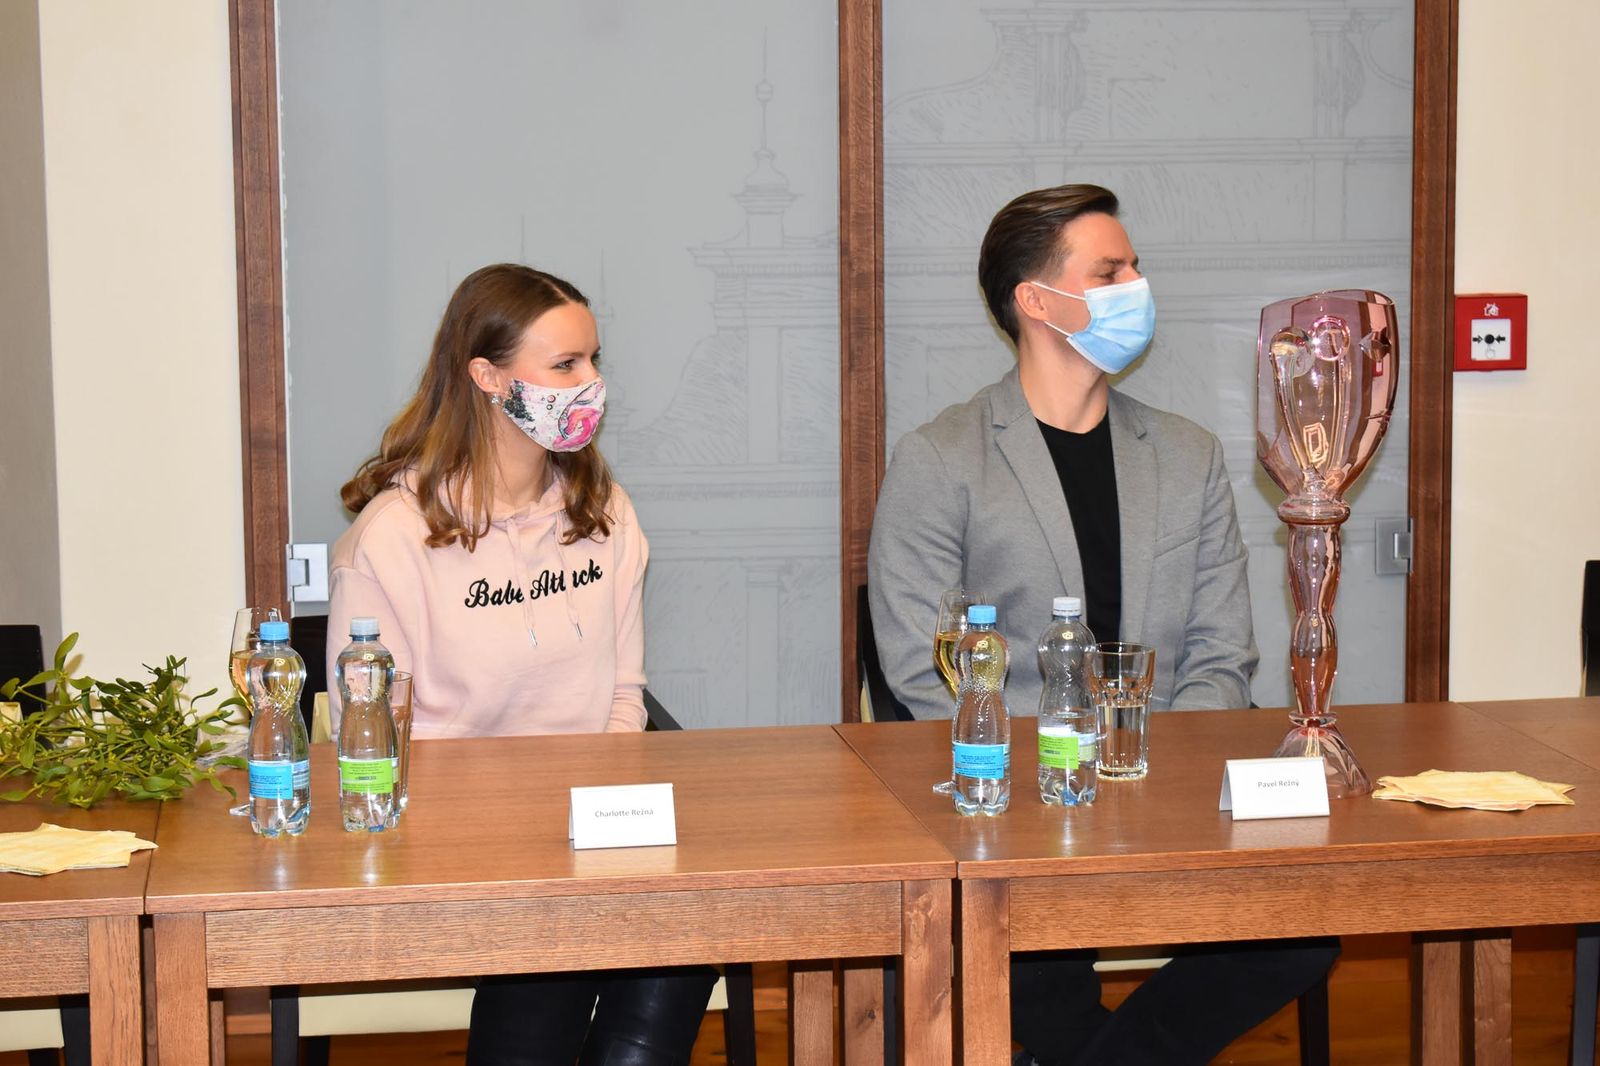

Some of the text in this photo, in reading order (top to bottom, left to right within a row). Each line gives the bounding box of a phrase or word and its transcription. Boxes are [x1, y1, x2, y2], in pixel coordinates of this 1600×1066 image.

[464, 577, 525, 608] Babe
[1257, 779, 1277, 788] Pavel
[594, 809, 630, 818] Charlotte
